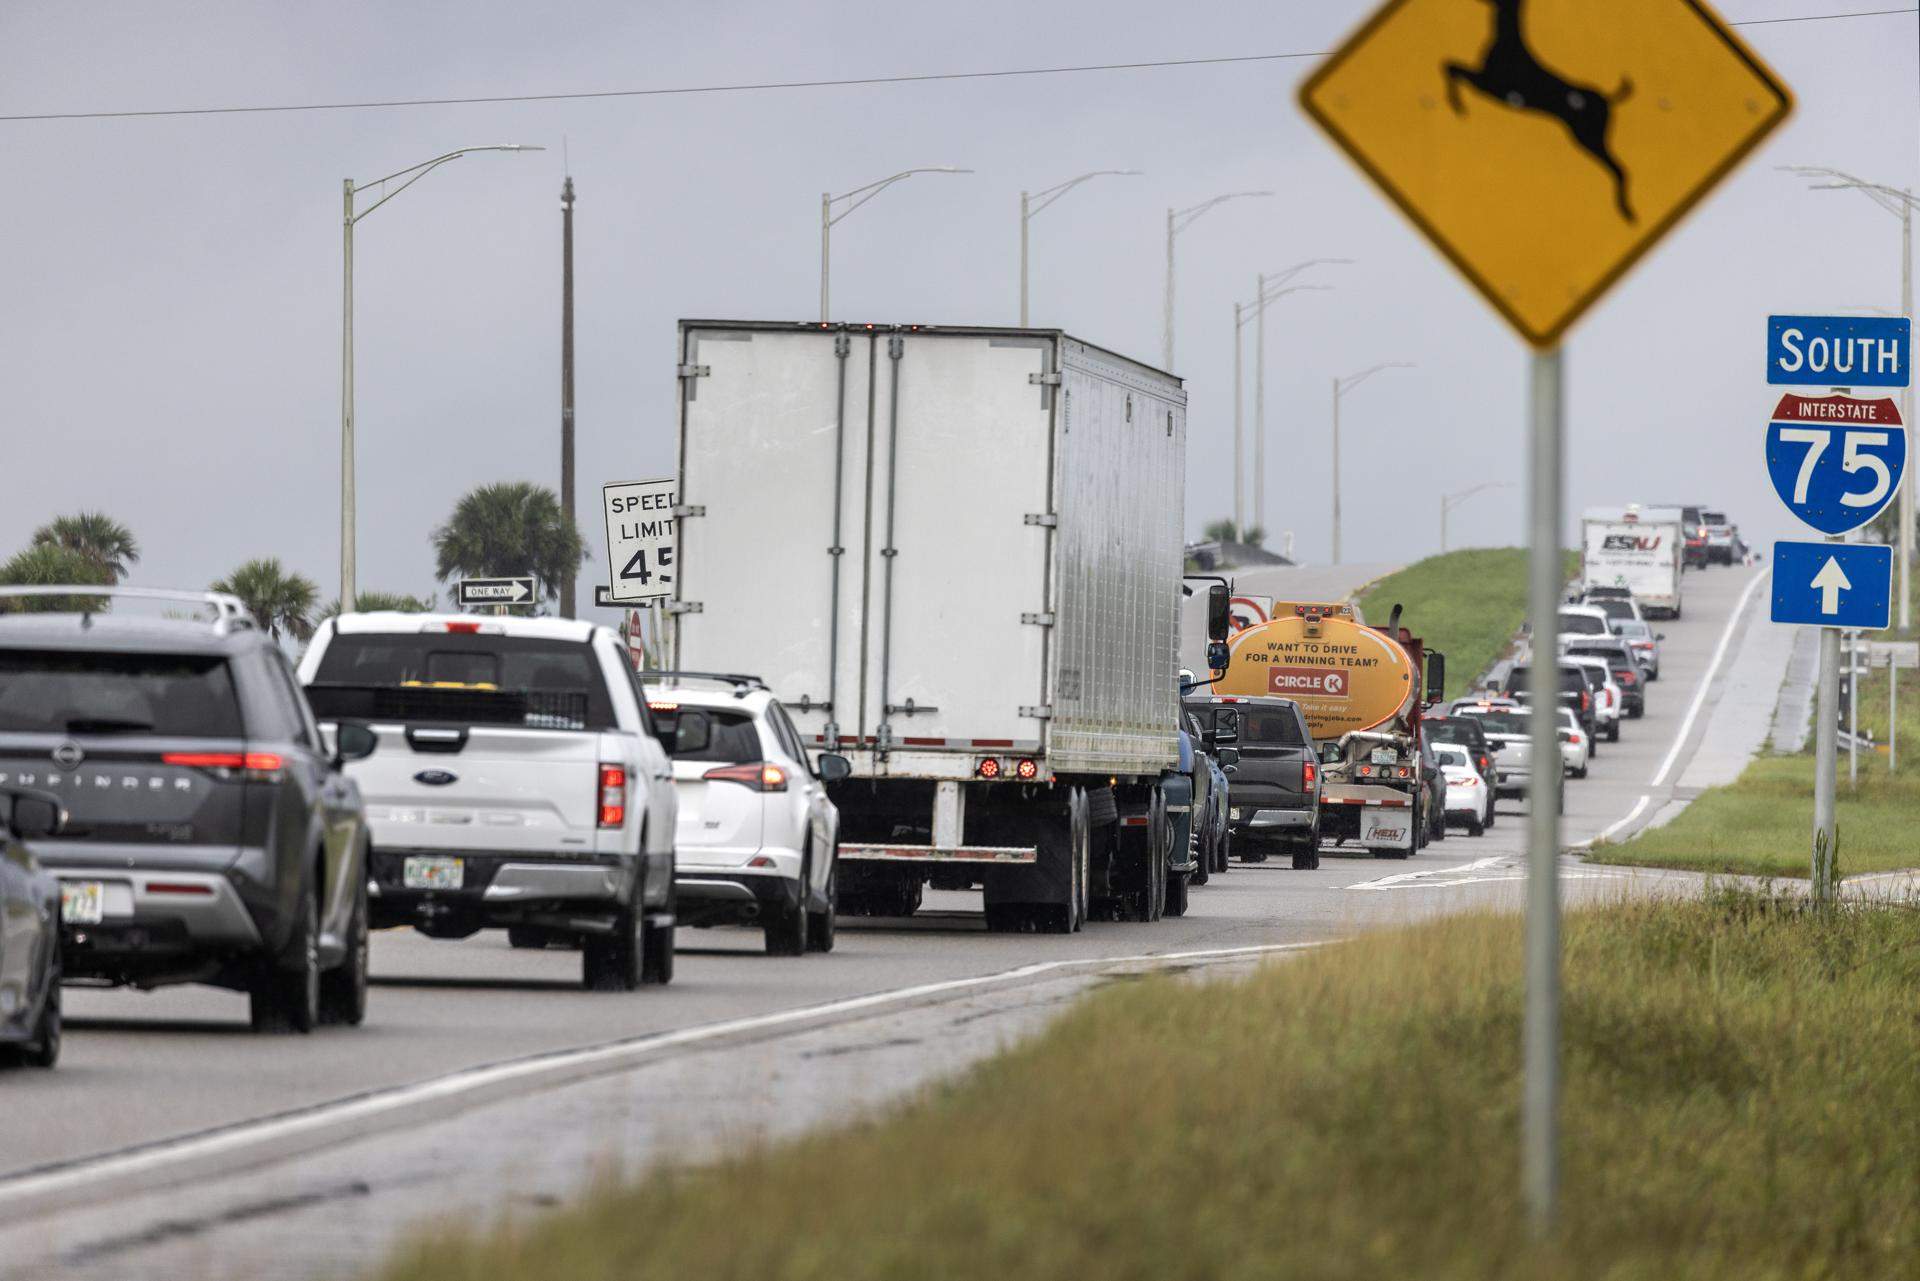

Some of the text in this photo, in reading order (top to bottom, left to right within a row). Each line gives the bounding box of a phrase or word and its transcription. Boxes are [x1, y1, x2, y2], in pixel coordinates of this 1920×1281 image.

[1779, 328, 1899, 373] SOUTH
[1799, 403, 1877, 420] INTERSTATE
[1779, 428, 1891, 508] 75
[621, 519, 673, 540] LIMIT
[471, 587, 511, 596] ONE WAY
[1267, 642, 1358, 655] WANT TO DRIVE
[1245, 653, 1379, 668] FOR A WINNING TEAM?
[1275, 675, 1321, 689] CIRCLE
